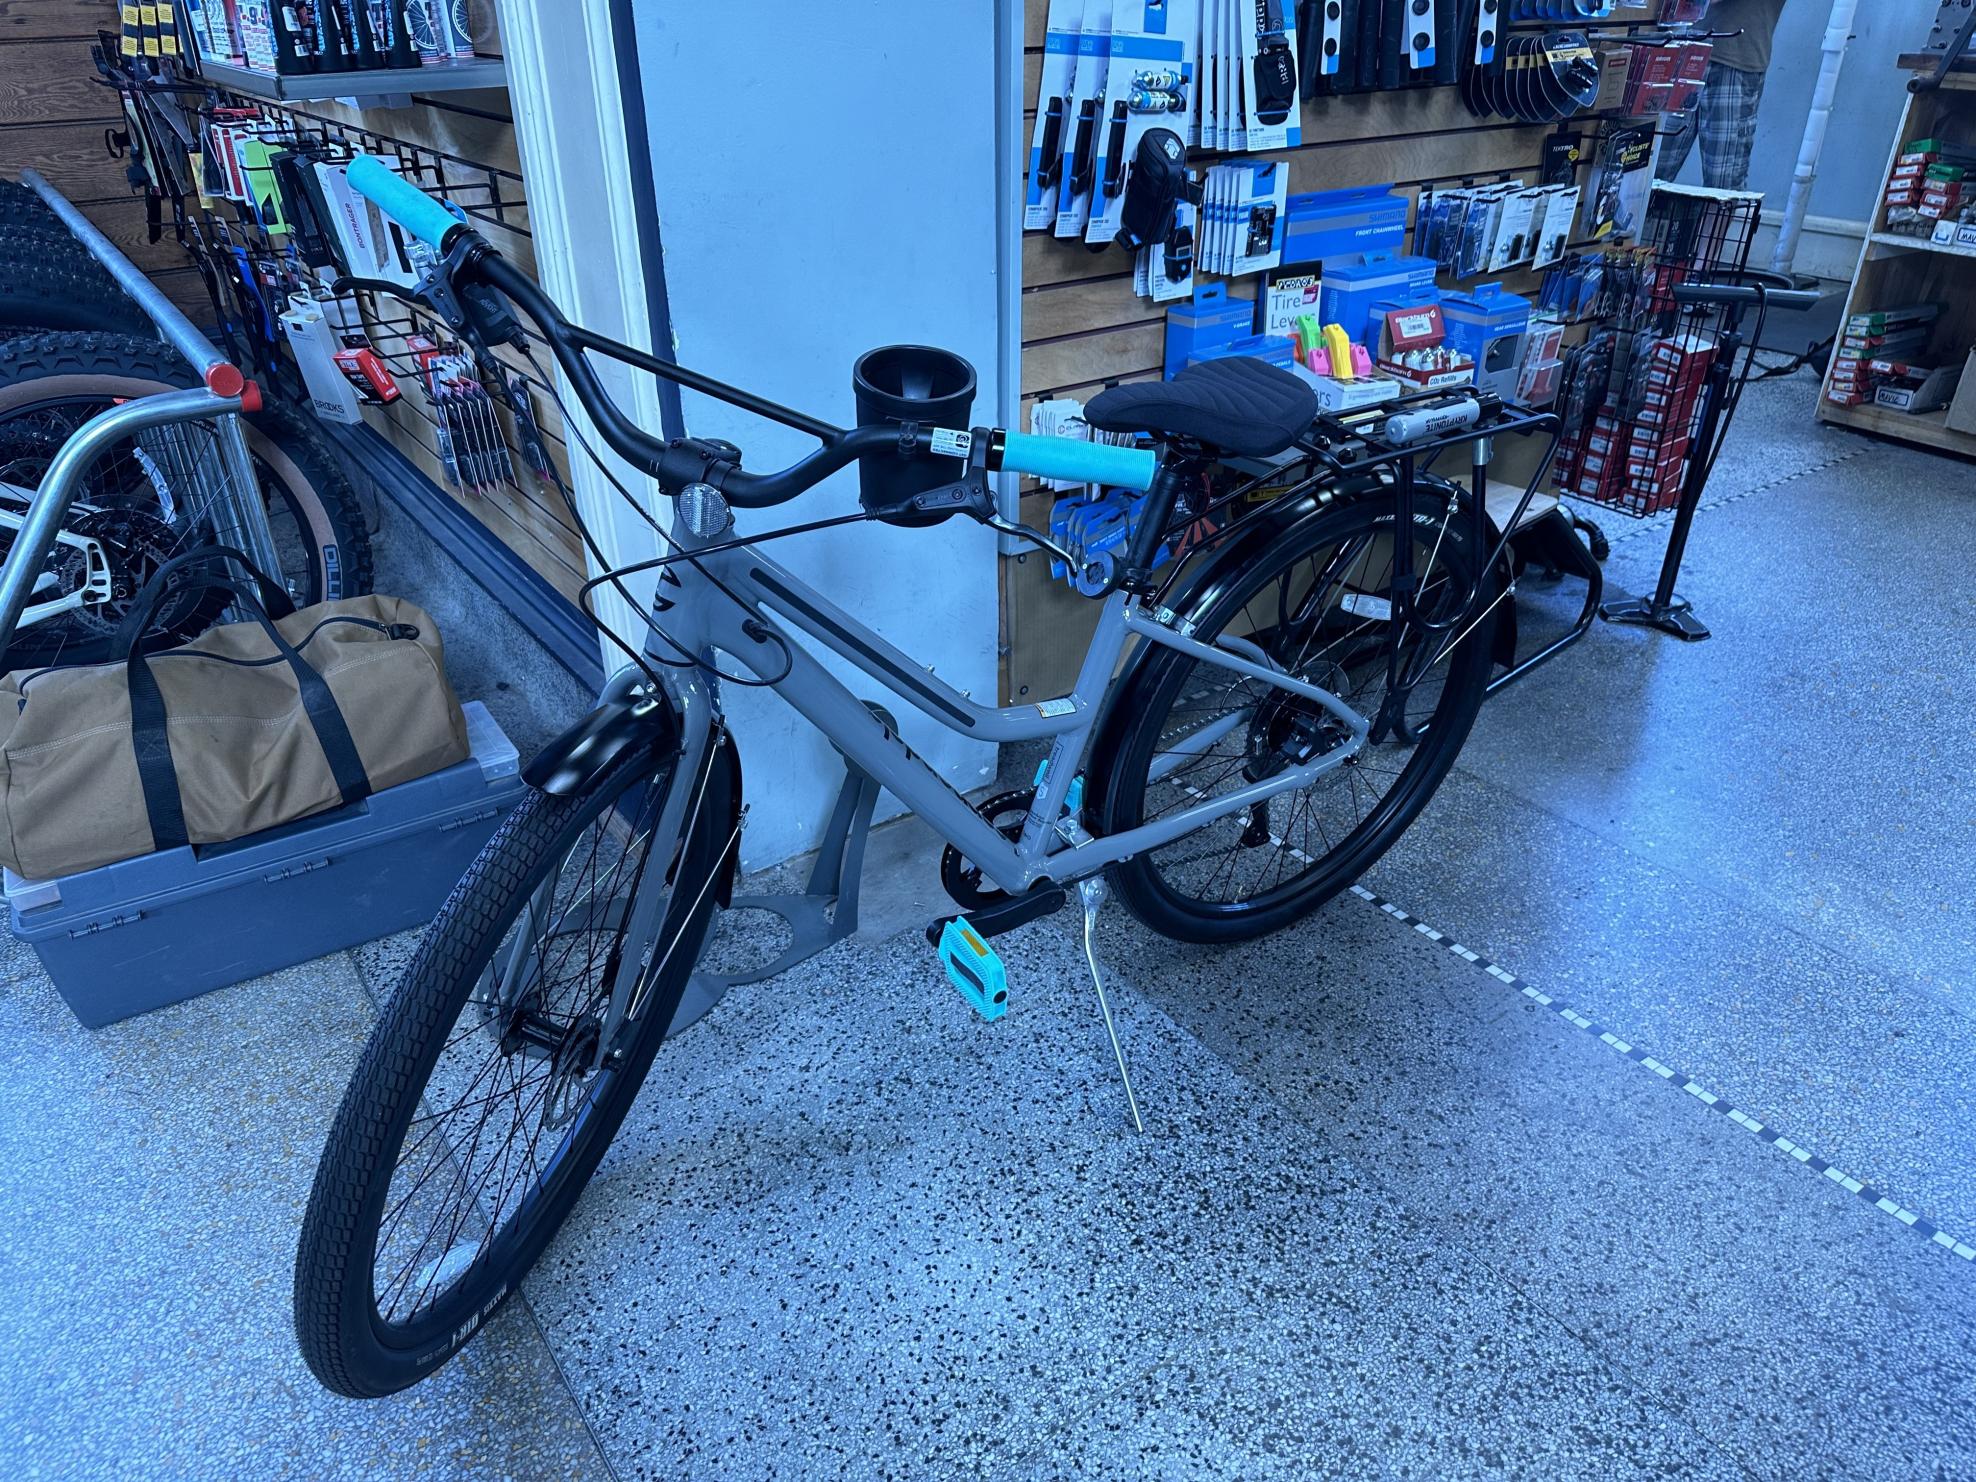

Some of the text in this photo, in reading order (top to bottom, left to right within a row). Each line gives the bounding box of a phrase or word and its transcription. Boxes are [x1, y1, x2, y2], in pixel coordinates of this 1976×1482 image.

[1368, 209, 1406, 223] SHIMANO
[344, 202, 366, 249] BONTRAGER
[1355, 224, 1404, 237] FRONT CHAINWHEEL
[1408, 269, 1435, 281] SHIMANO
[1271, 294, 1301, 310] Tire
[1219, 309, 1252, 320] SHIMANO
[1440, 375, 1457, 383] Refills
[314, 399, 345, 414] BROOKS
[1425, 414, 1468, 433] KRYPTONITE
[483, 1282, 507, 1317] MAXXIS
